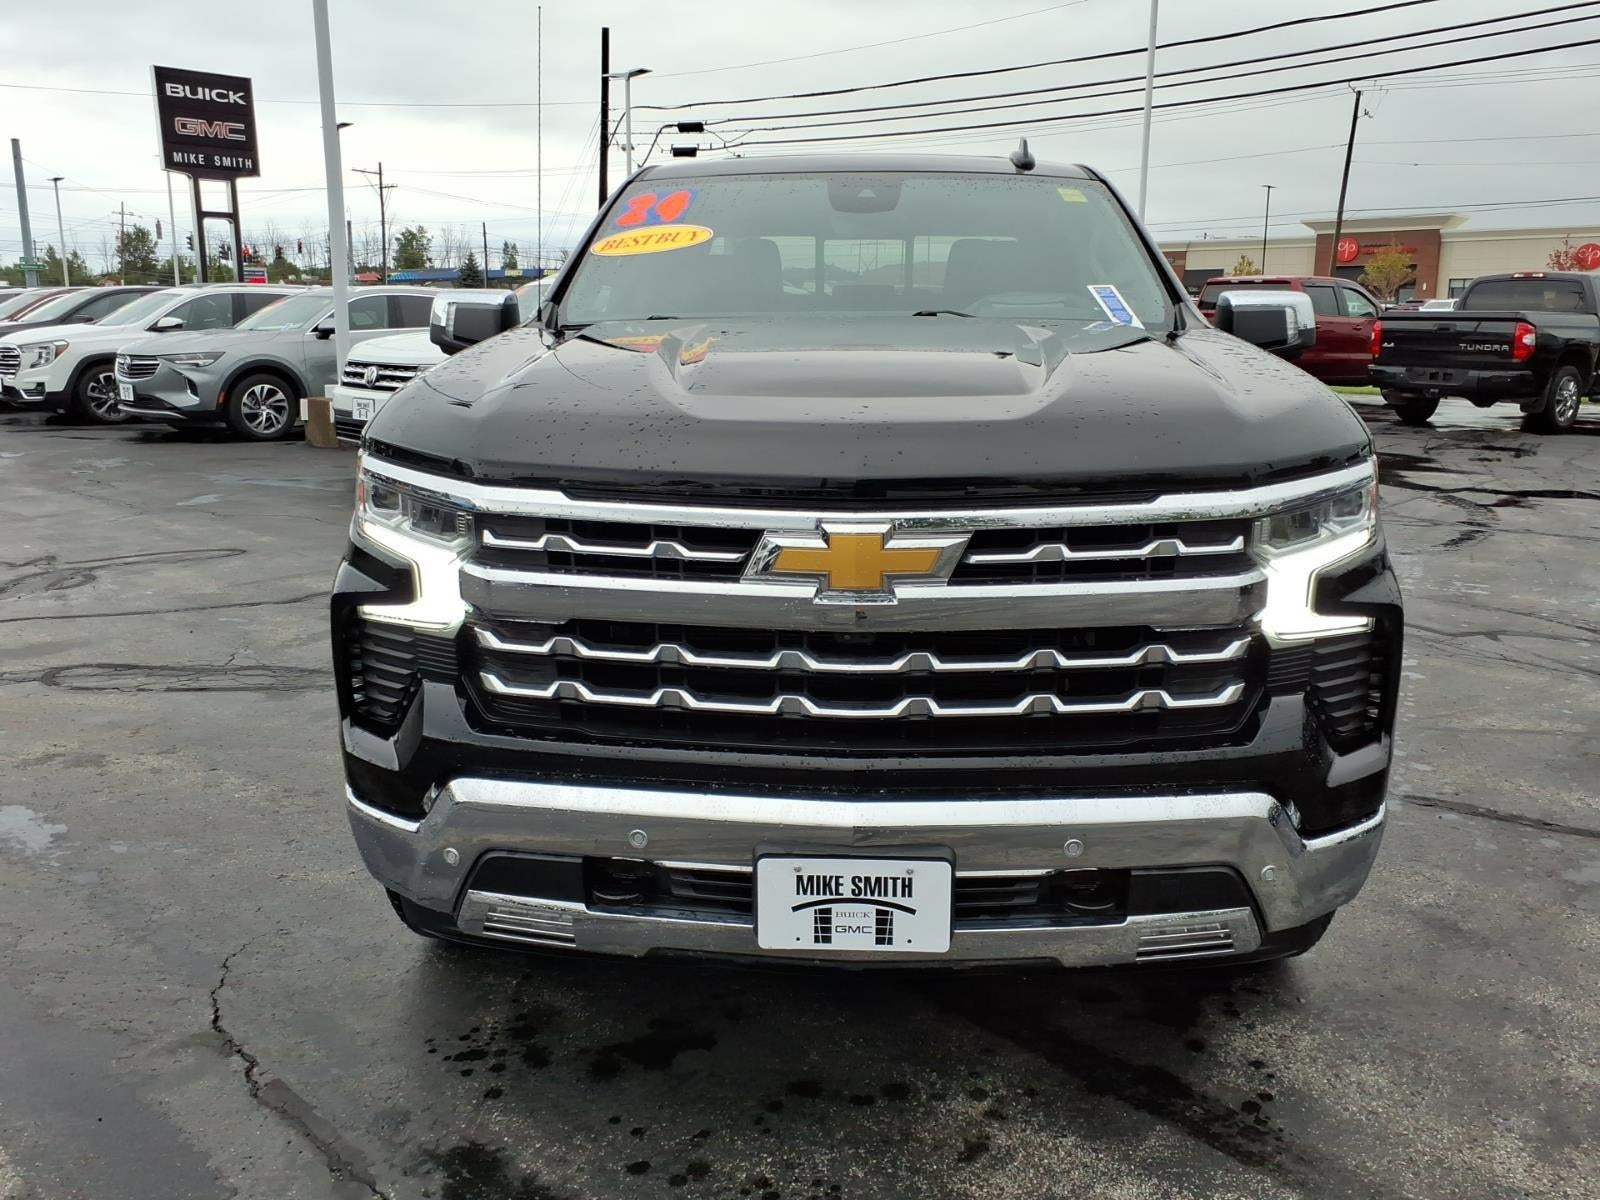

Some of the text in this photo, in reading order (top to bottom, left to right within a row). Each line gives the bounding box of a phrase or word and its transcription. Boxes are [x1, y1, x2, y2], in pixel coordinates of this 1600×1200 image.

[165, 83, 247, 105] BUICK
[174, 117, 246, 141] GMC
[173, 152, 252, 169] MIKE SMITH
[1459, 343, 1509, 351] TUNDRA
[796, 874, 913, 898] MIKE SMITH
[835, 925, 873, 934] GMC
